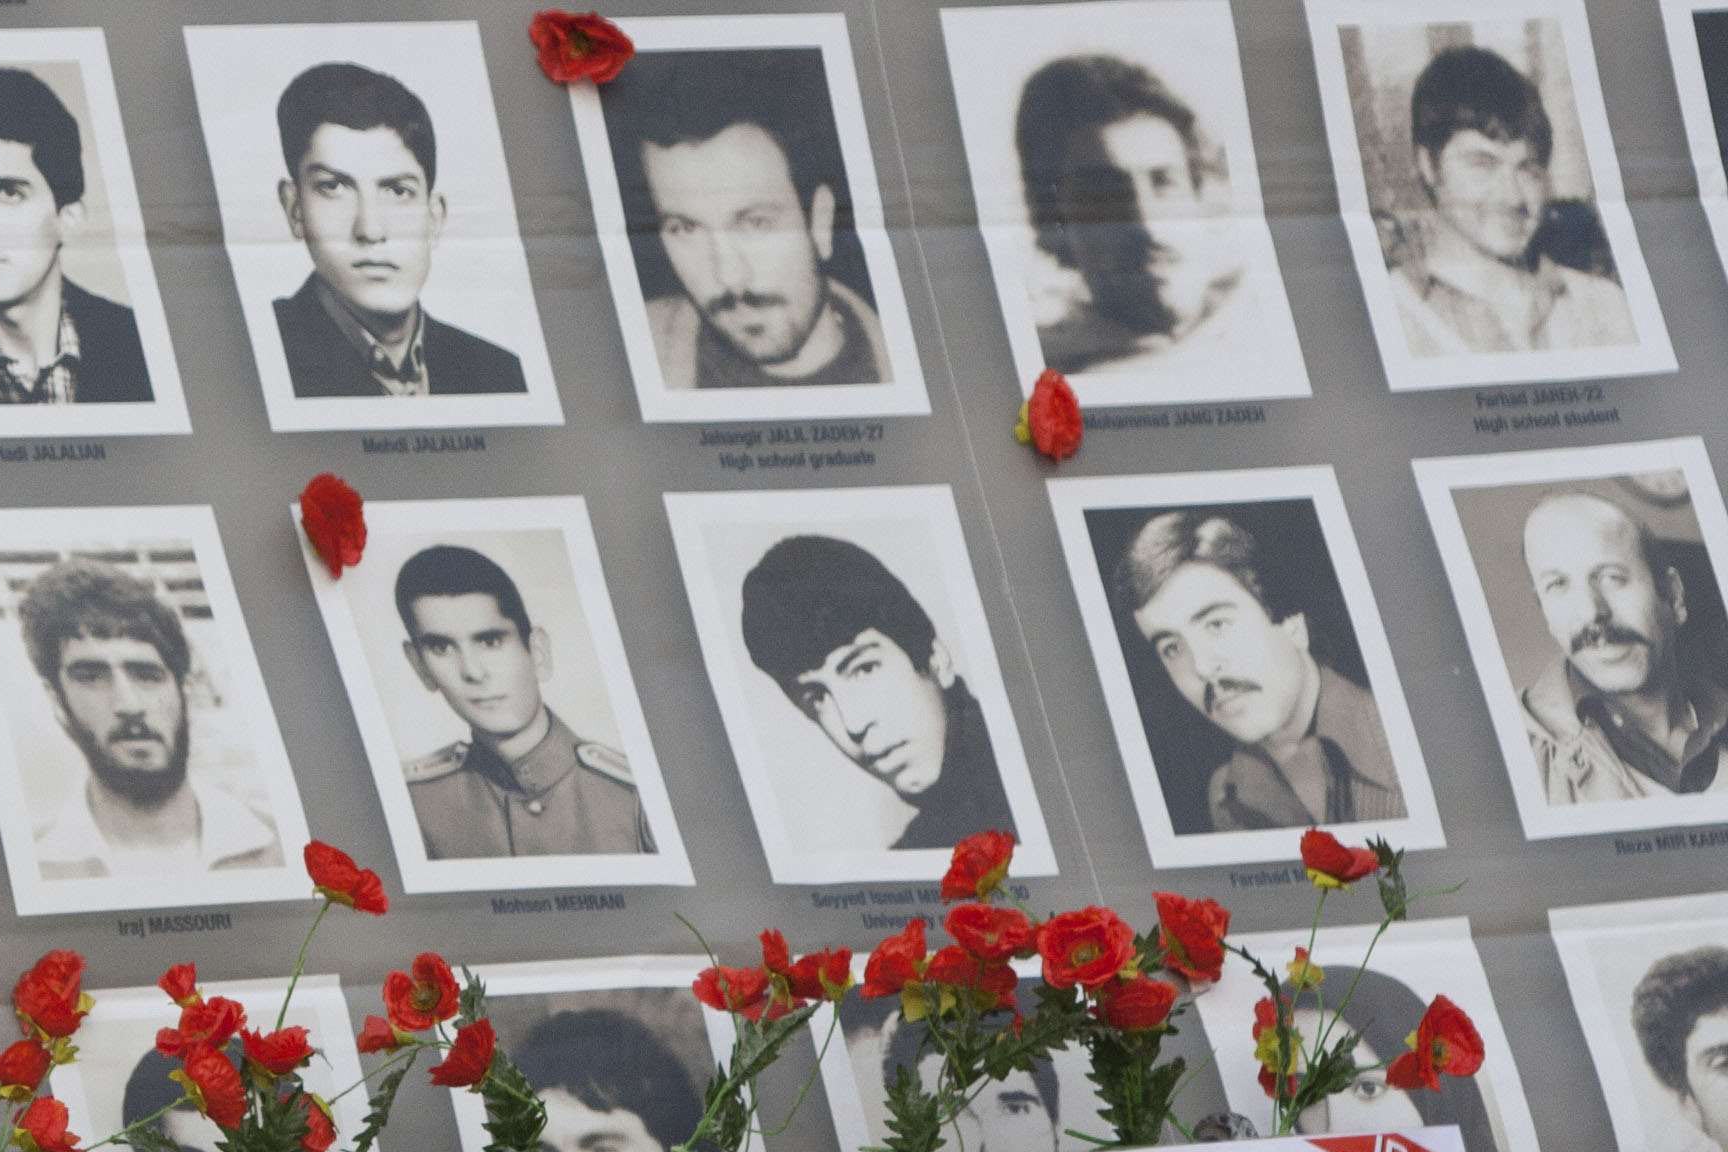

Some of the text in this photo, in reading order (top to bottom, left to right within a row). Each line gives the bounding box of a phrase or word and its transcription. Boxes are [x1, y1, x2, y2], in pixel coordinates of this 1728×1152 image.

[1473, 414, 1508, 434] High
[1511, 410, 1561, 430] school
[719, 449, 876, 471] High school graduate
[491, 894, 626, 915] Mohsen MEHRANI
[117, 913, 232, 939] Iraj MASSOURI
